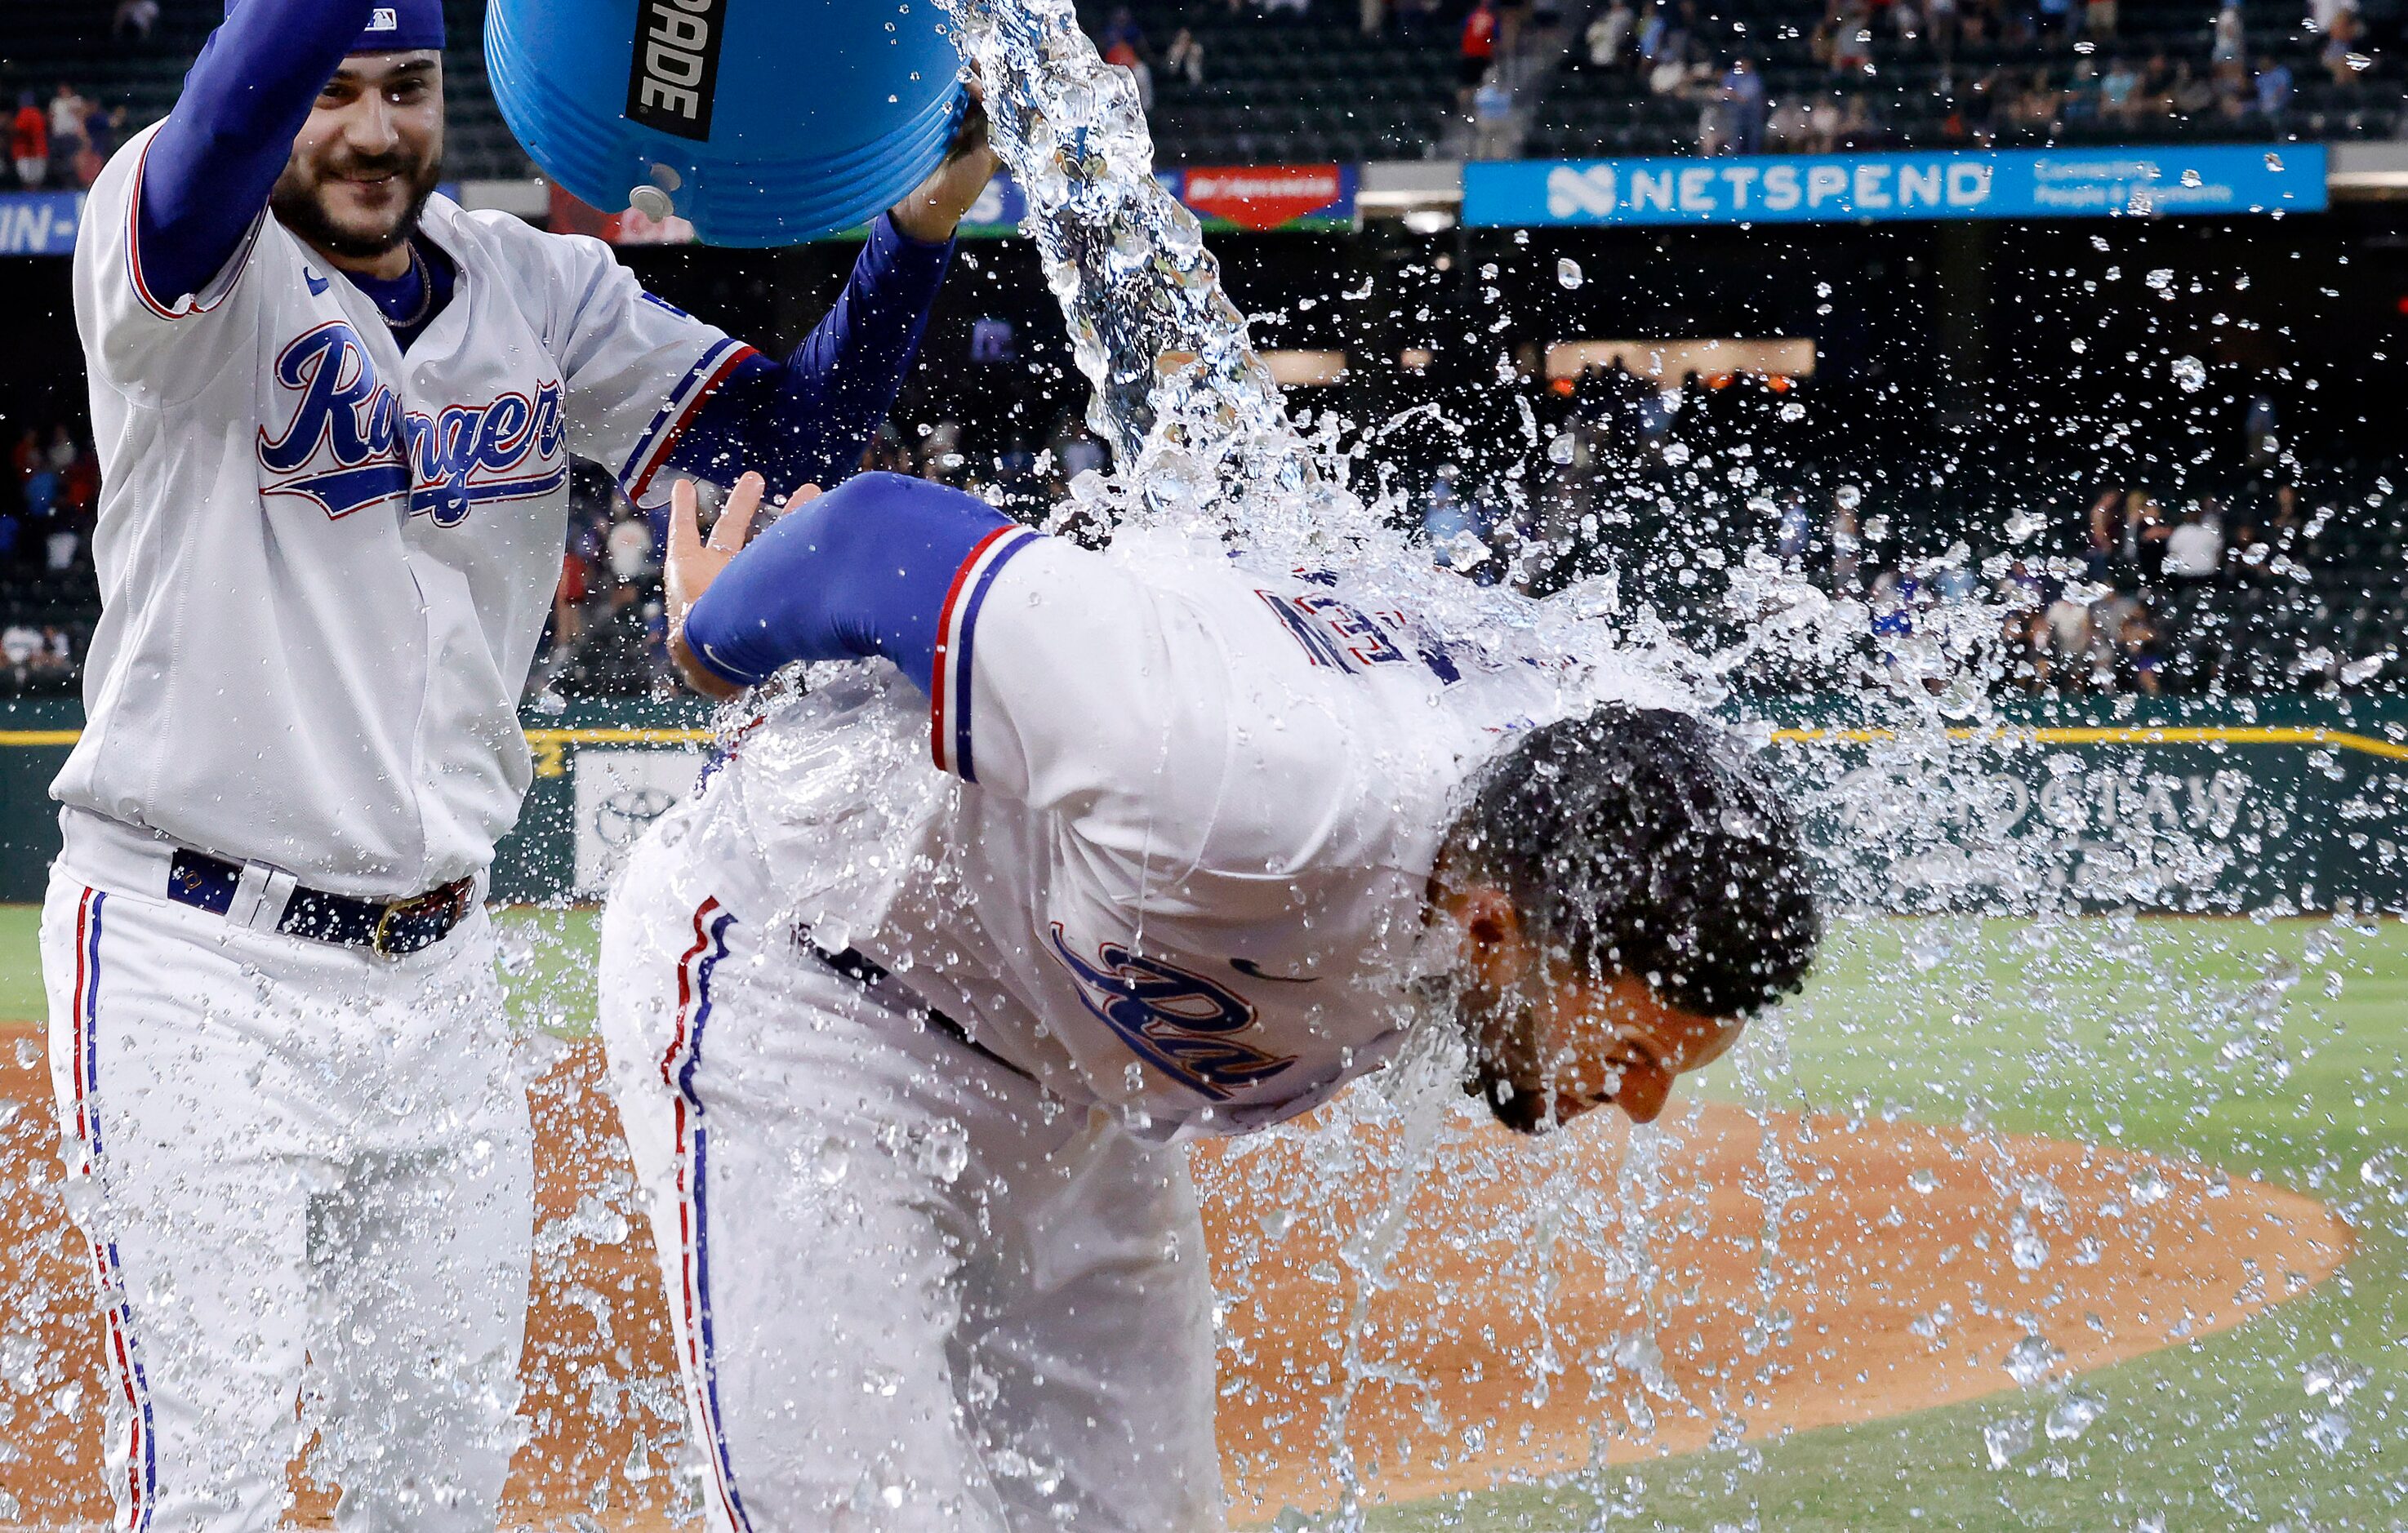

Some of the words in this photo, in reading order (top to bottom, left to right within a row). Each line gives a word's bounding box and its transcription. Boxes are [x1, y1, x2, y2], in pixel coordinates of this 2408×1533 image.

[640, 0, 713, 119] ADE
[1631, 163, 1992, 211] NETSPEND
[256, 320, 567, 528] Ranger
